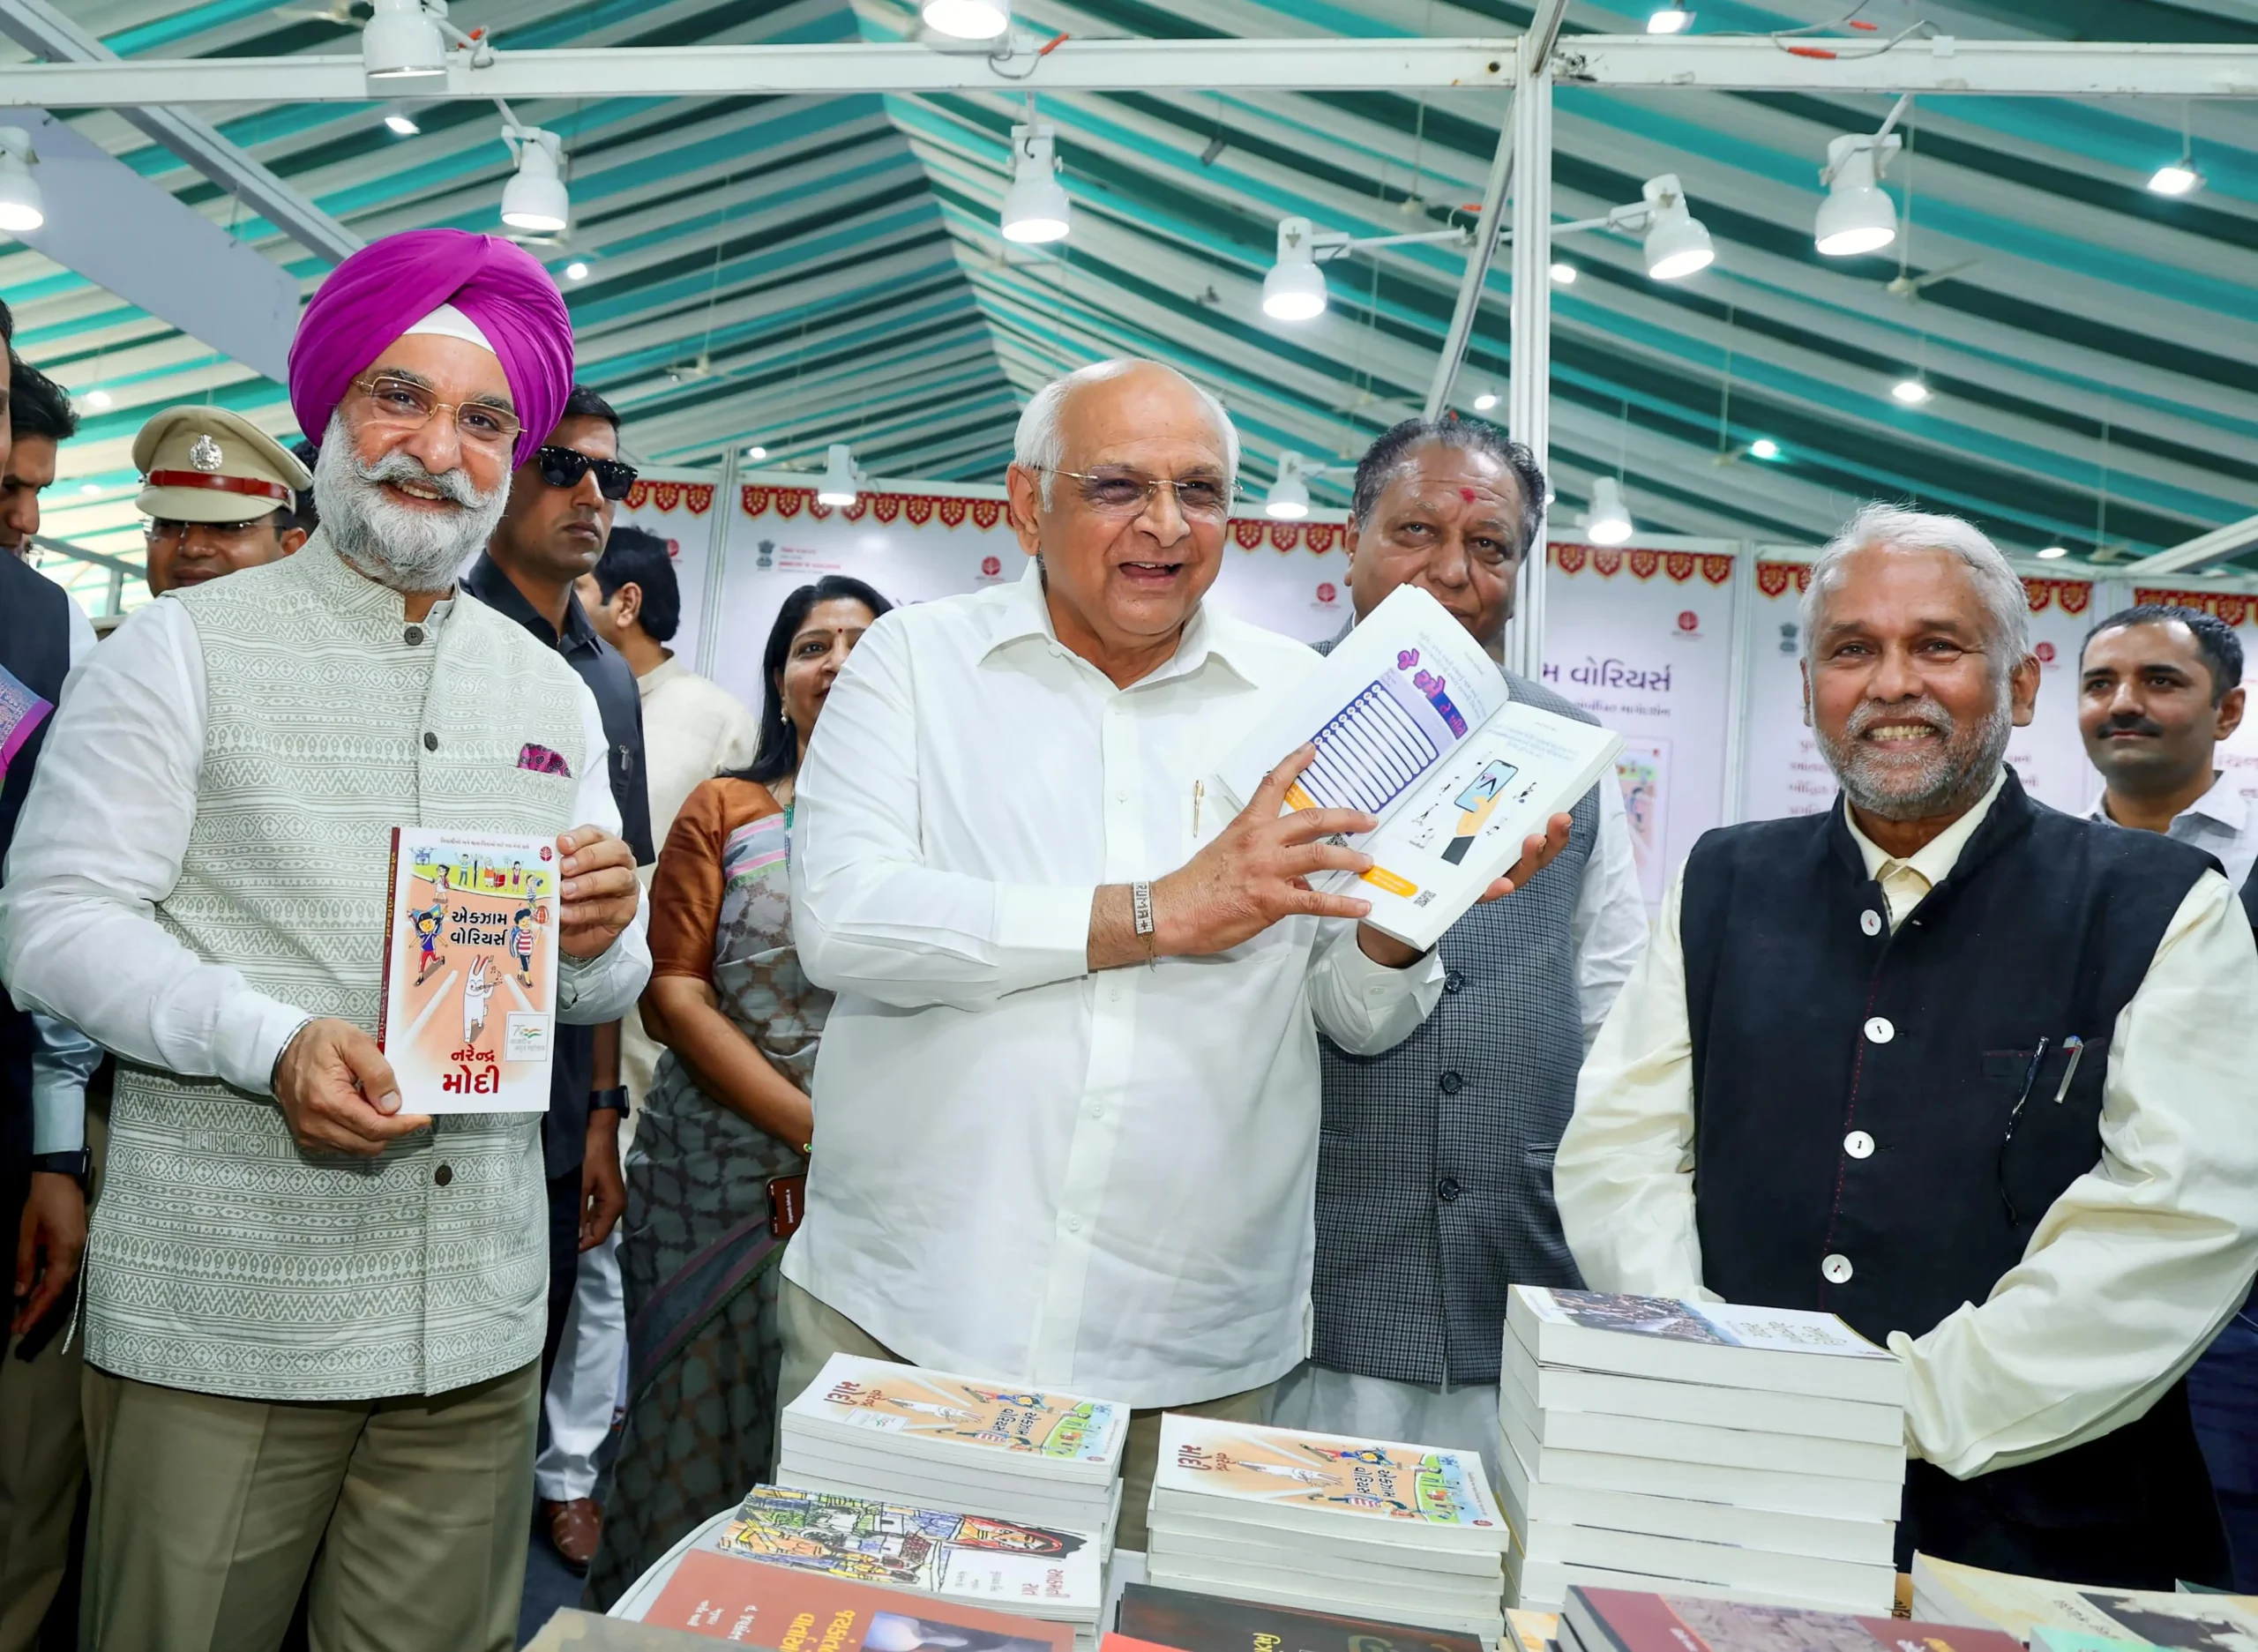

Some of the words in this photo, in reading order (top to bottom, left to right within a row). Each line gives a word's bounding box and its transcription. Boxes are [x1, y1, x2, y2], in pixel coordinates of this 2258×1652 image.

[1571, 655, 1674, 691] વોરિયર્સ
[451, 927, 508, 946] વોરિયર્સ
[451, 1044, 495, 1062] નરેન્દ્ર
[443, 1065, 499, 1094] મોદી
[824, 1380, 867, 1406] મોદી
[1178, 1445, 1212, 1470] મોદી
